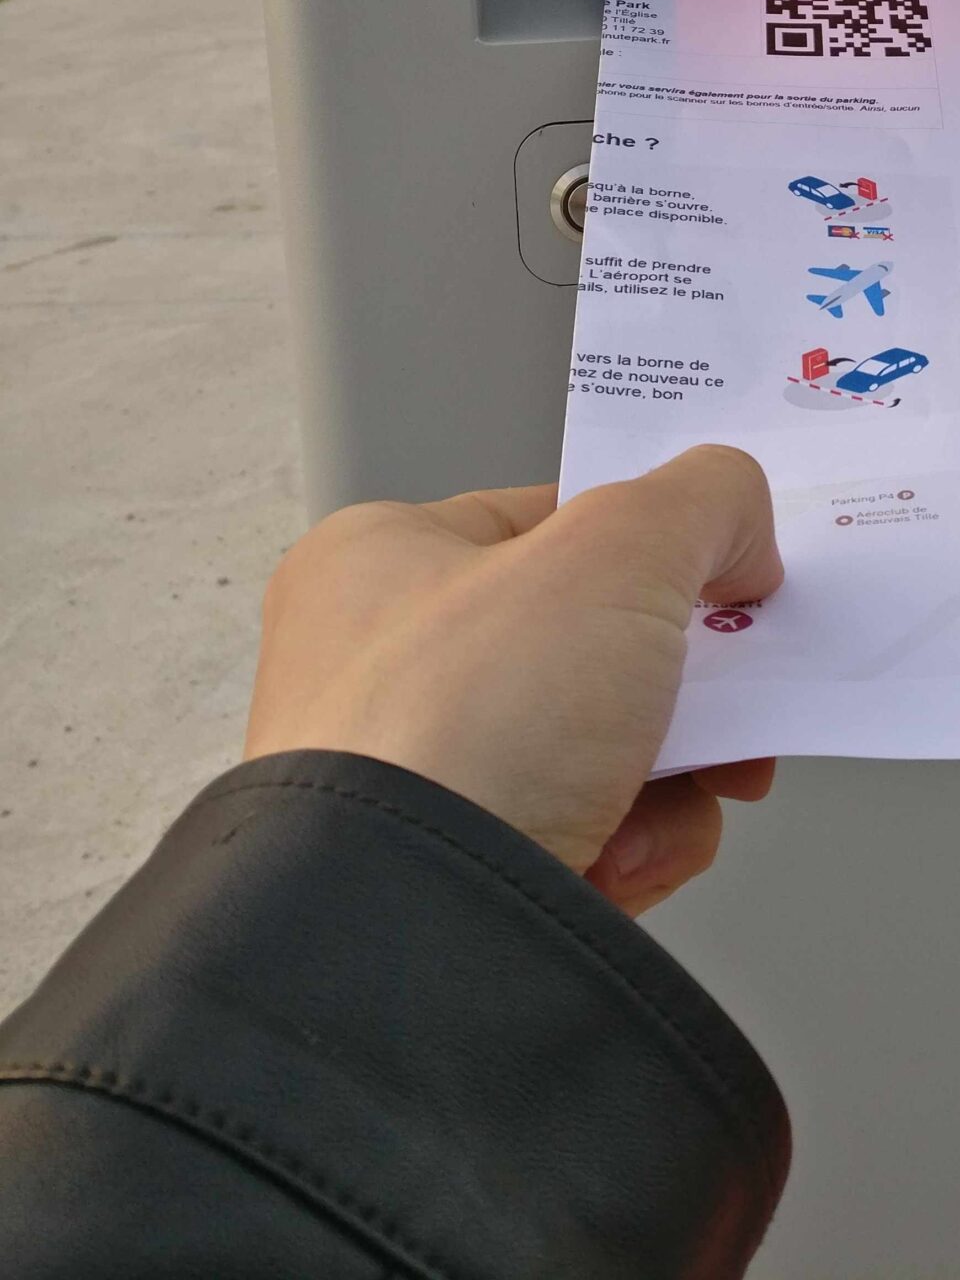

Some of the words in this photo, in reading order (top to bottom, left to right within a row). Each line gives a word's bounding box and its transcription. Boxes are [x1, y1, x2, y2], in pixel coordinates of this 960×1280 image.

[616, 0, 650, 10] Park
[619, 82, 645, 91] vous
[649, 86, 686, 95] servira
[689, 89, 744, 99] également
[787, 94, 817, 102] sortie
[836, 97, 880, 105] parking.
[629, 92, 651, 100] pour
[667, 96, 707, 105] scanner
[859, 105, 887, 113] Ainsi,
[592, 133, 636, 148] che
[645, 137, 660, 150] ?
[631, 185, 644, 195] la
[593, 192, 651, 207] barrière
[655, 199, 713, 212] s'ouvre.
[603, 206, 644, 217] place
[648, 210, 728, 225] disponible.
[585, 257, 622, 267] suffit
[628, 258, 647, 268] de
[652, 260, 712, 275] prendre
[589, 268, 669, 283] L'aéroport
[673, 276, 692, 285] se
[614, 283, 668, 296] utilisez
[673, 287, 687, 297] le
[691, 289, 724, 301] plan
[577, 353, 611, 364] vers
[617, 354, 631, 366] la
[637, 356, 684, 370] borne
[689, 359, 710, 371] de
[602, 369, 623, 381] de
[628, 372, 699, 387] nouveau
[704, 377, 724, 388] ce
[652, 387, 683, 401] bon
[831, 495, 876, 506] Parking
[912, 506, 928, 514] de
[857, 517, 911, 526] Beauvais
